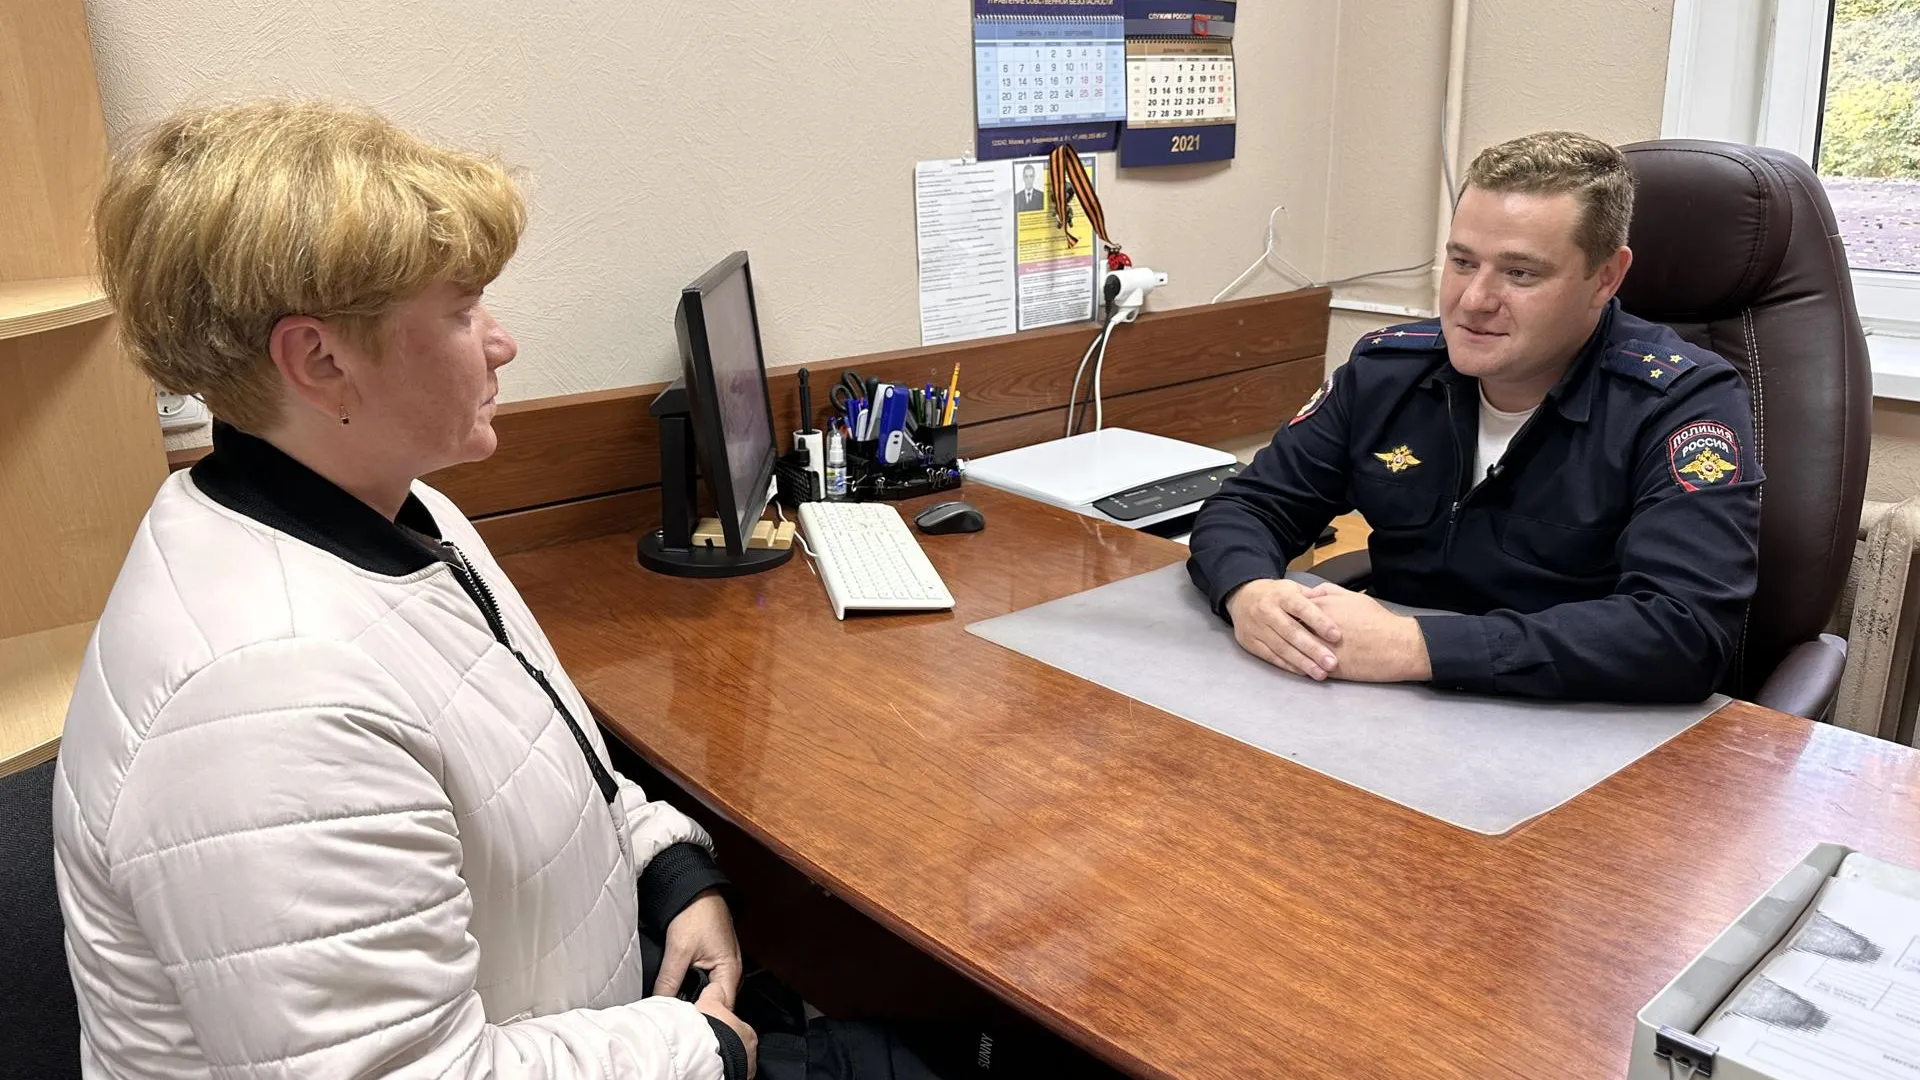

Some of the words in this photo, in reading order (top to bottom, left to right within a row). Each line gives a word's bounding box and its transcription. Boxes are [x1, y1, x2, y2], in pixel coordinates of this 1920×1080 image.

[1035, 50, 1040, 58] 1
[1050, 50, 1056, 58] 2
[1066, 50, 1072, 58] 3
[1081, 49, 1087, 57] 4
[1003, 64, 1008, 73] 6
[1019, 64, 1025, 72] 7
[1035, 64, 1040, 72] 8
[1051, 63, 1057, 72] 9
[1066, 63, 1074, 71] 10
[1080, 63, 1088, 71] 11
[1095, 62, 1103, 71] 12
[1002, 78, 1011, 87] 13
[1019, 78, 1027, 86] 14
[1034, 77, 1043, 86] 15
[1050, 77, 1059, 85] 16
[1065, 77, 1074, 85] 17
[1080, 76, 1089, 84] 18
[1001, 92, 1012, 101] 20
[1018, 91, 1027, 100] 21
[1034, 91, 1043, 100] 22
[1049, 91, 1059, 99] 23
[1065, 90, 1074, 98] 24
[1149, 87, 1157, 95] 13
[1002, 106, 1012, 115] 27
[1050, 104, 1059, 113] 30
[1148, 110, 1156, 118] 27
[1171, 134, 1200, 152] 2021
[1673, 425, 1734, 449] ПОЛИЦИЯ
[1682, 437, 1730, 457] РОССИЯ
[978, 1032, 993, 1070] SUNNY
